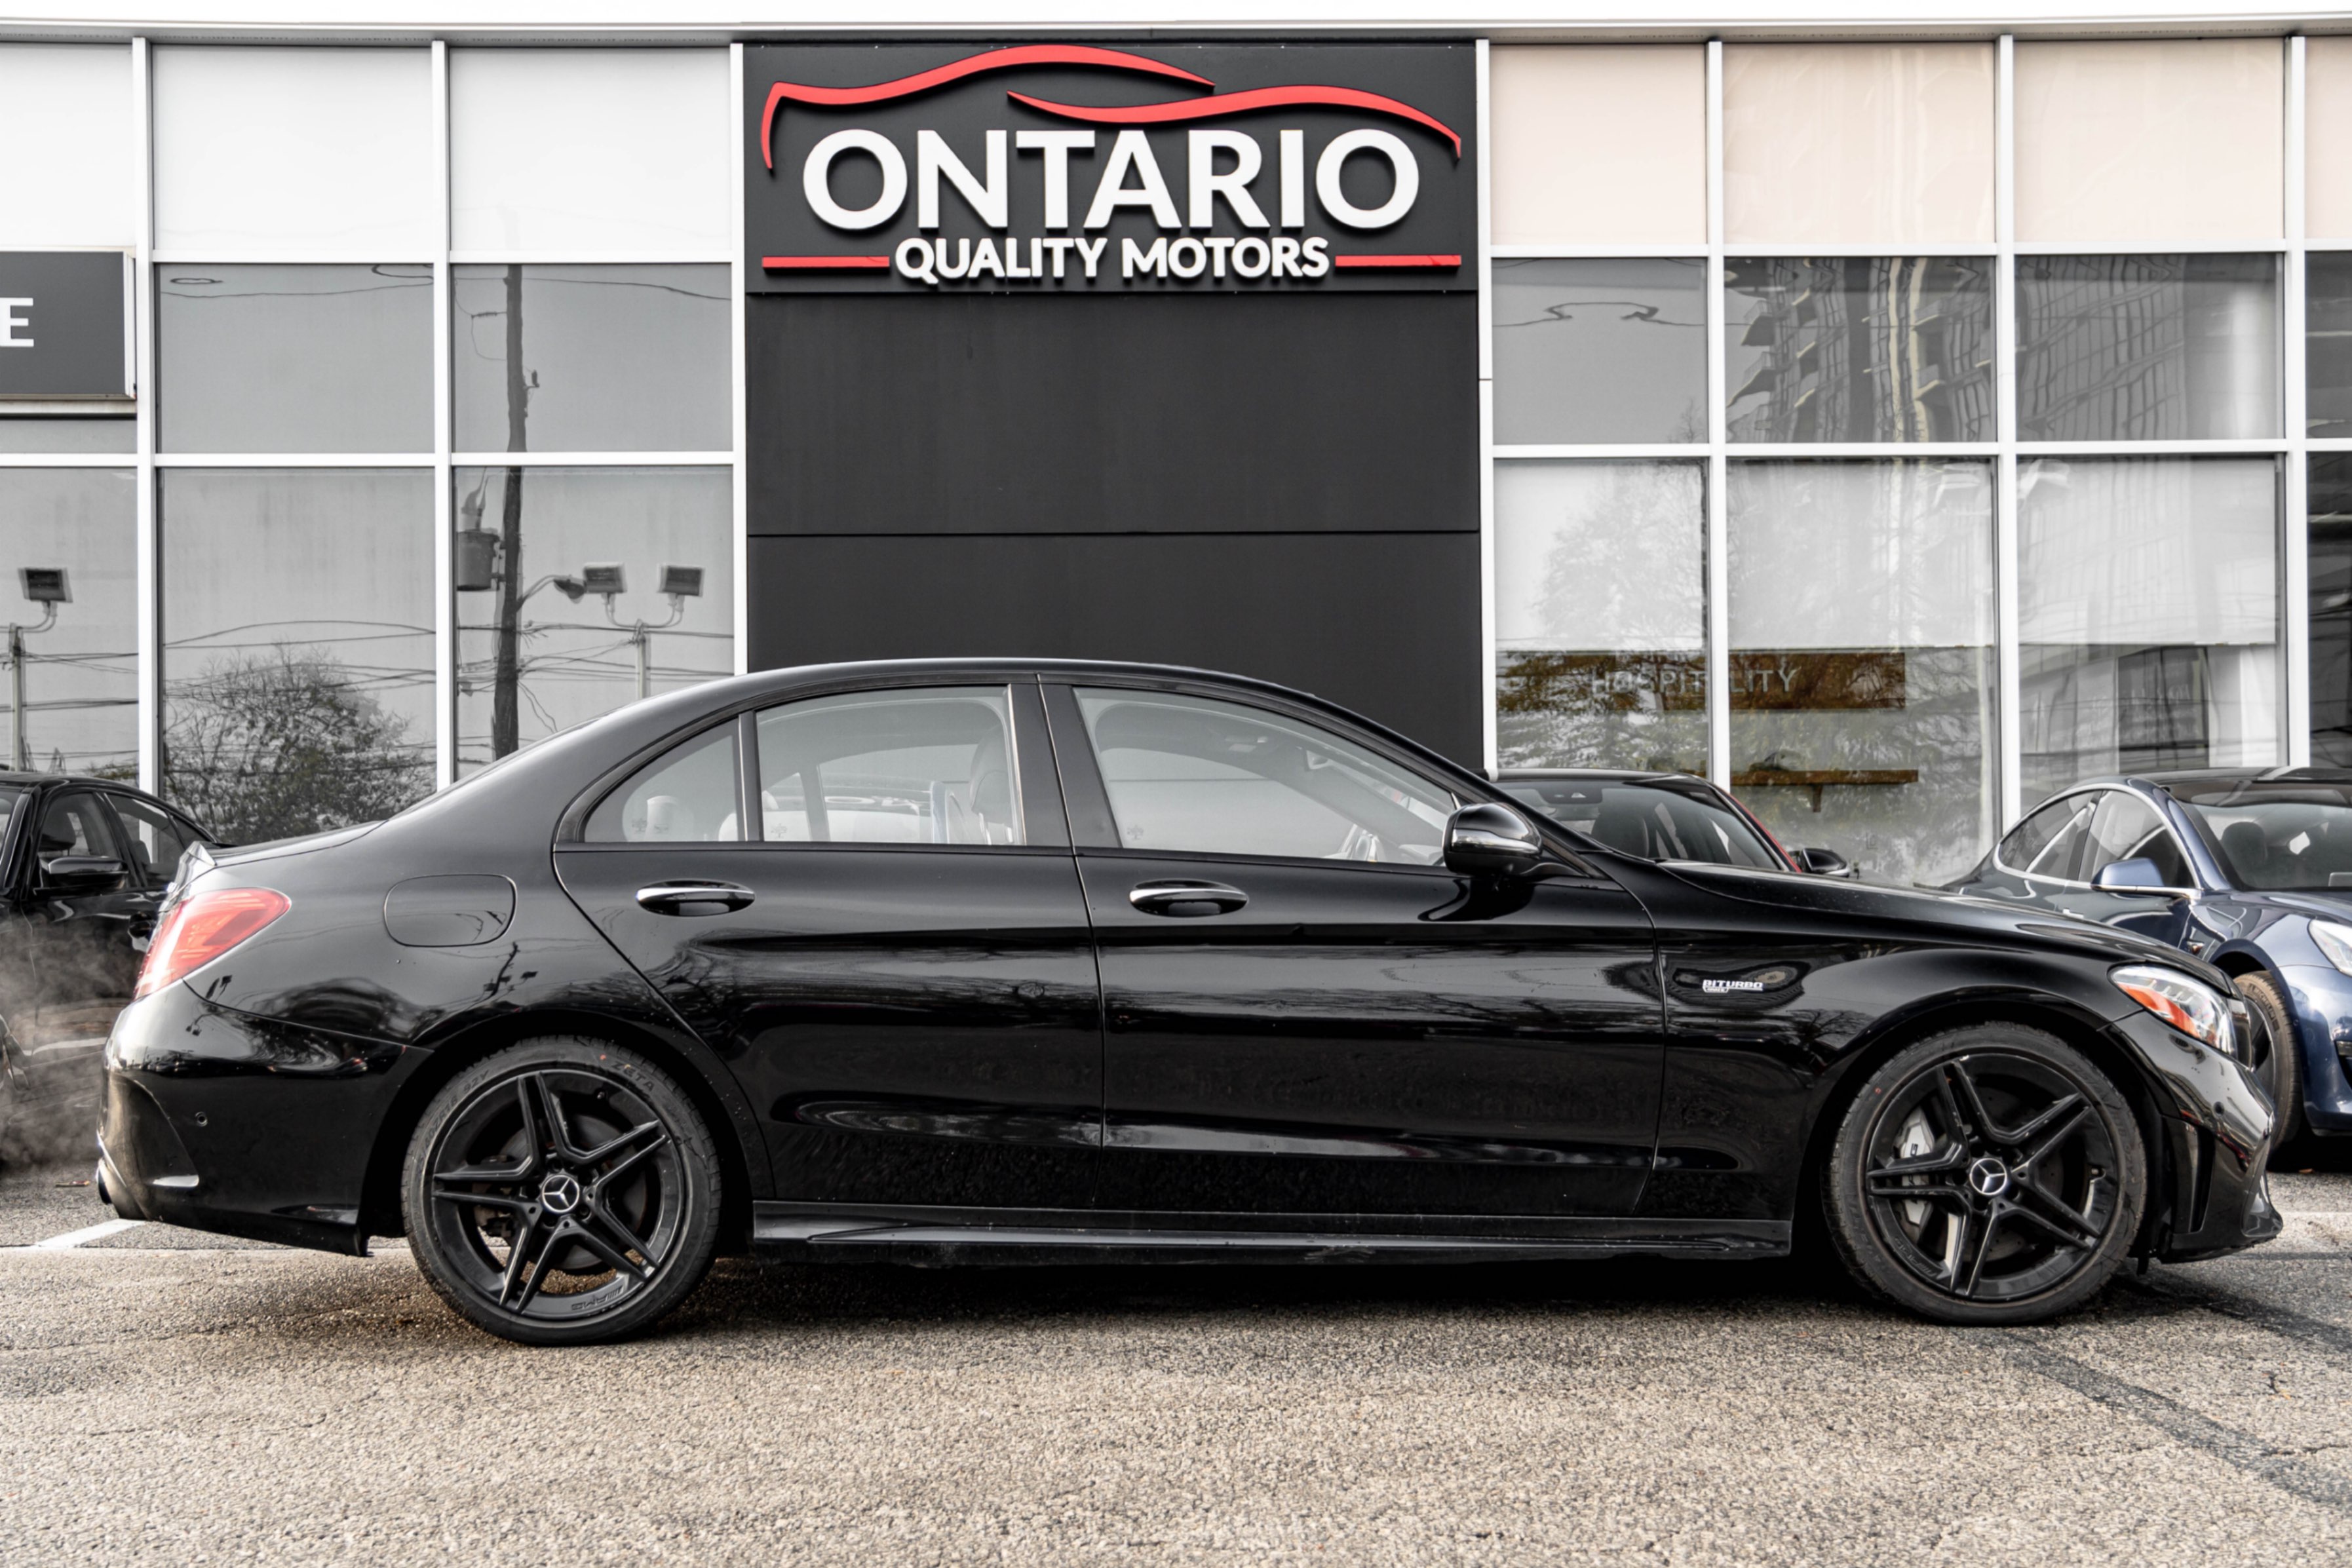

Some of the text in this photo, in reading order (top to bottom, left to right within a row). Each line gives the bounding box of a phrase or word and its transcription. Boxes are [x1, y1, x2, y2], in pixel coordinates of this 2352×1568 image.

[803, 129, 1419, 229] ONTARIO
[895, 237, 1330, 284] QUALITY MOTORS
[1592, 667, 1798, 693] HOSPITLITY
[1703, 979, 1764, 988] BITURBO
[2248, 983, 2276, 1020] MICHELIN
[463, 1070, 489, 1094] 92Y
[611, 1061, 655, 1092] ZETA
